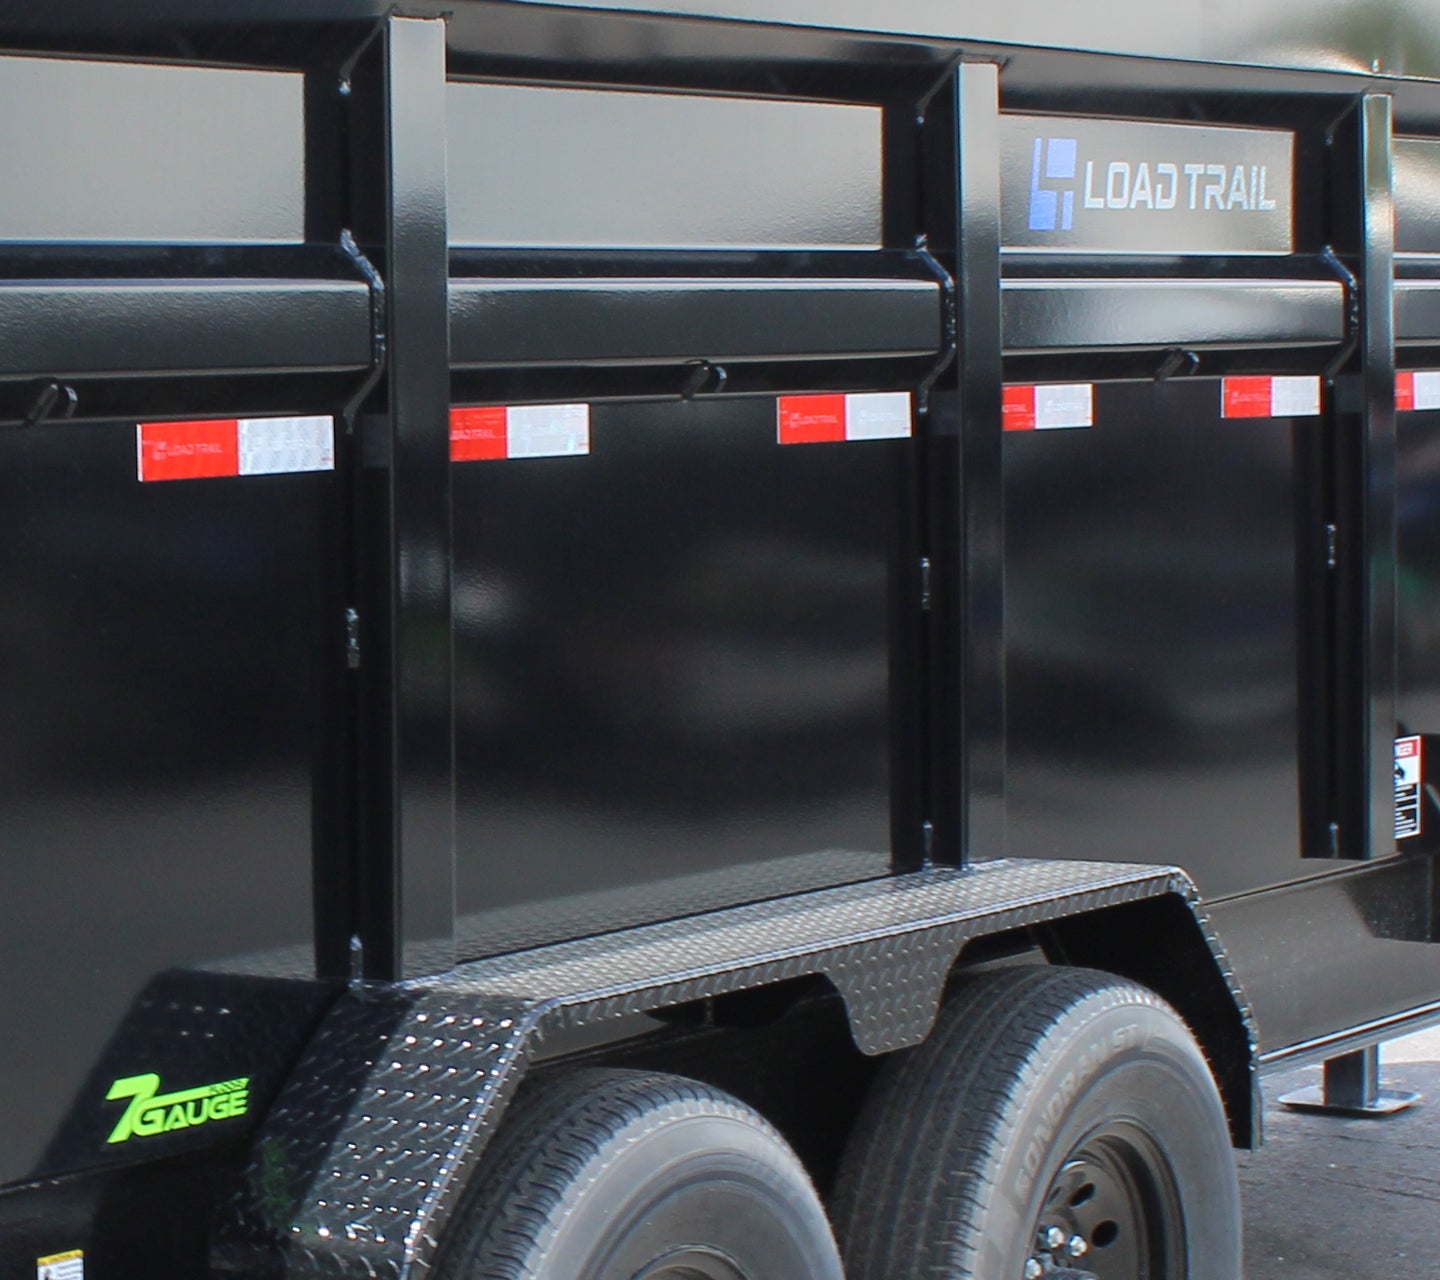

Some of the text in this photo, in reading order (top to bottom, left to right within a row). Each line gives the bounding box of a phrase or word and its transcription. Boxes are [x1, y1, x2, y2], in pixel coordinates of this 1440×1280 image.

[1084, 160, 1277, 211] LOAD TRAIL
[105, 1072, 250, 1144] 7 GAUGE
